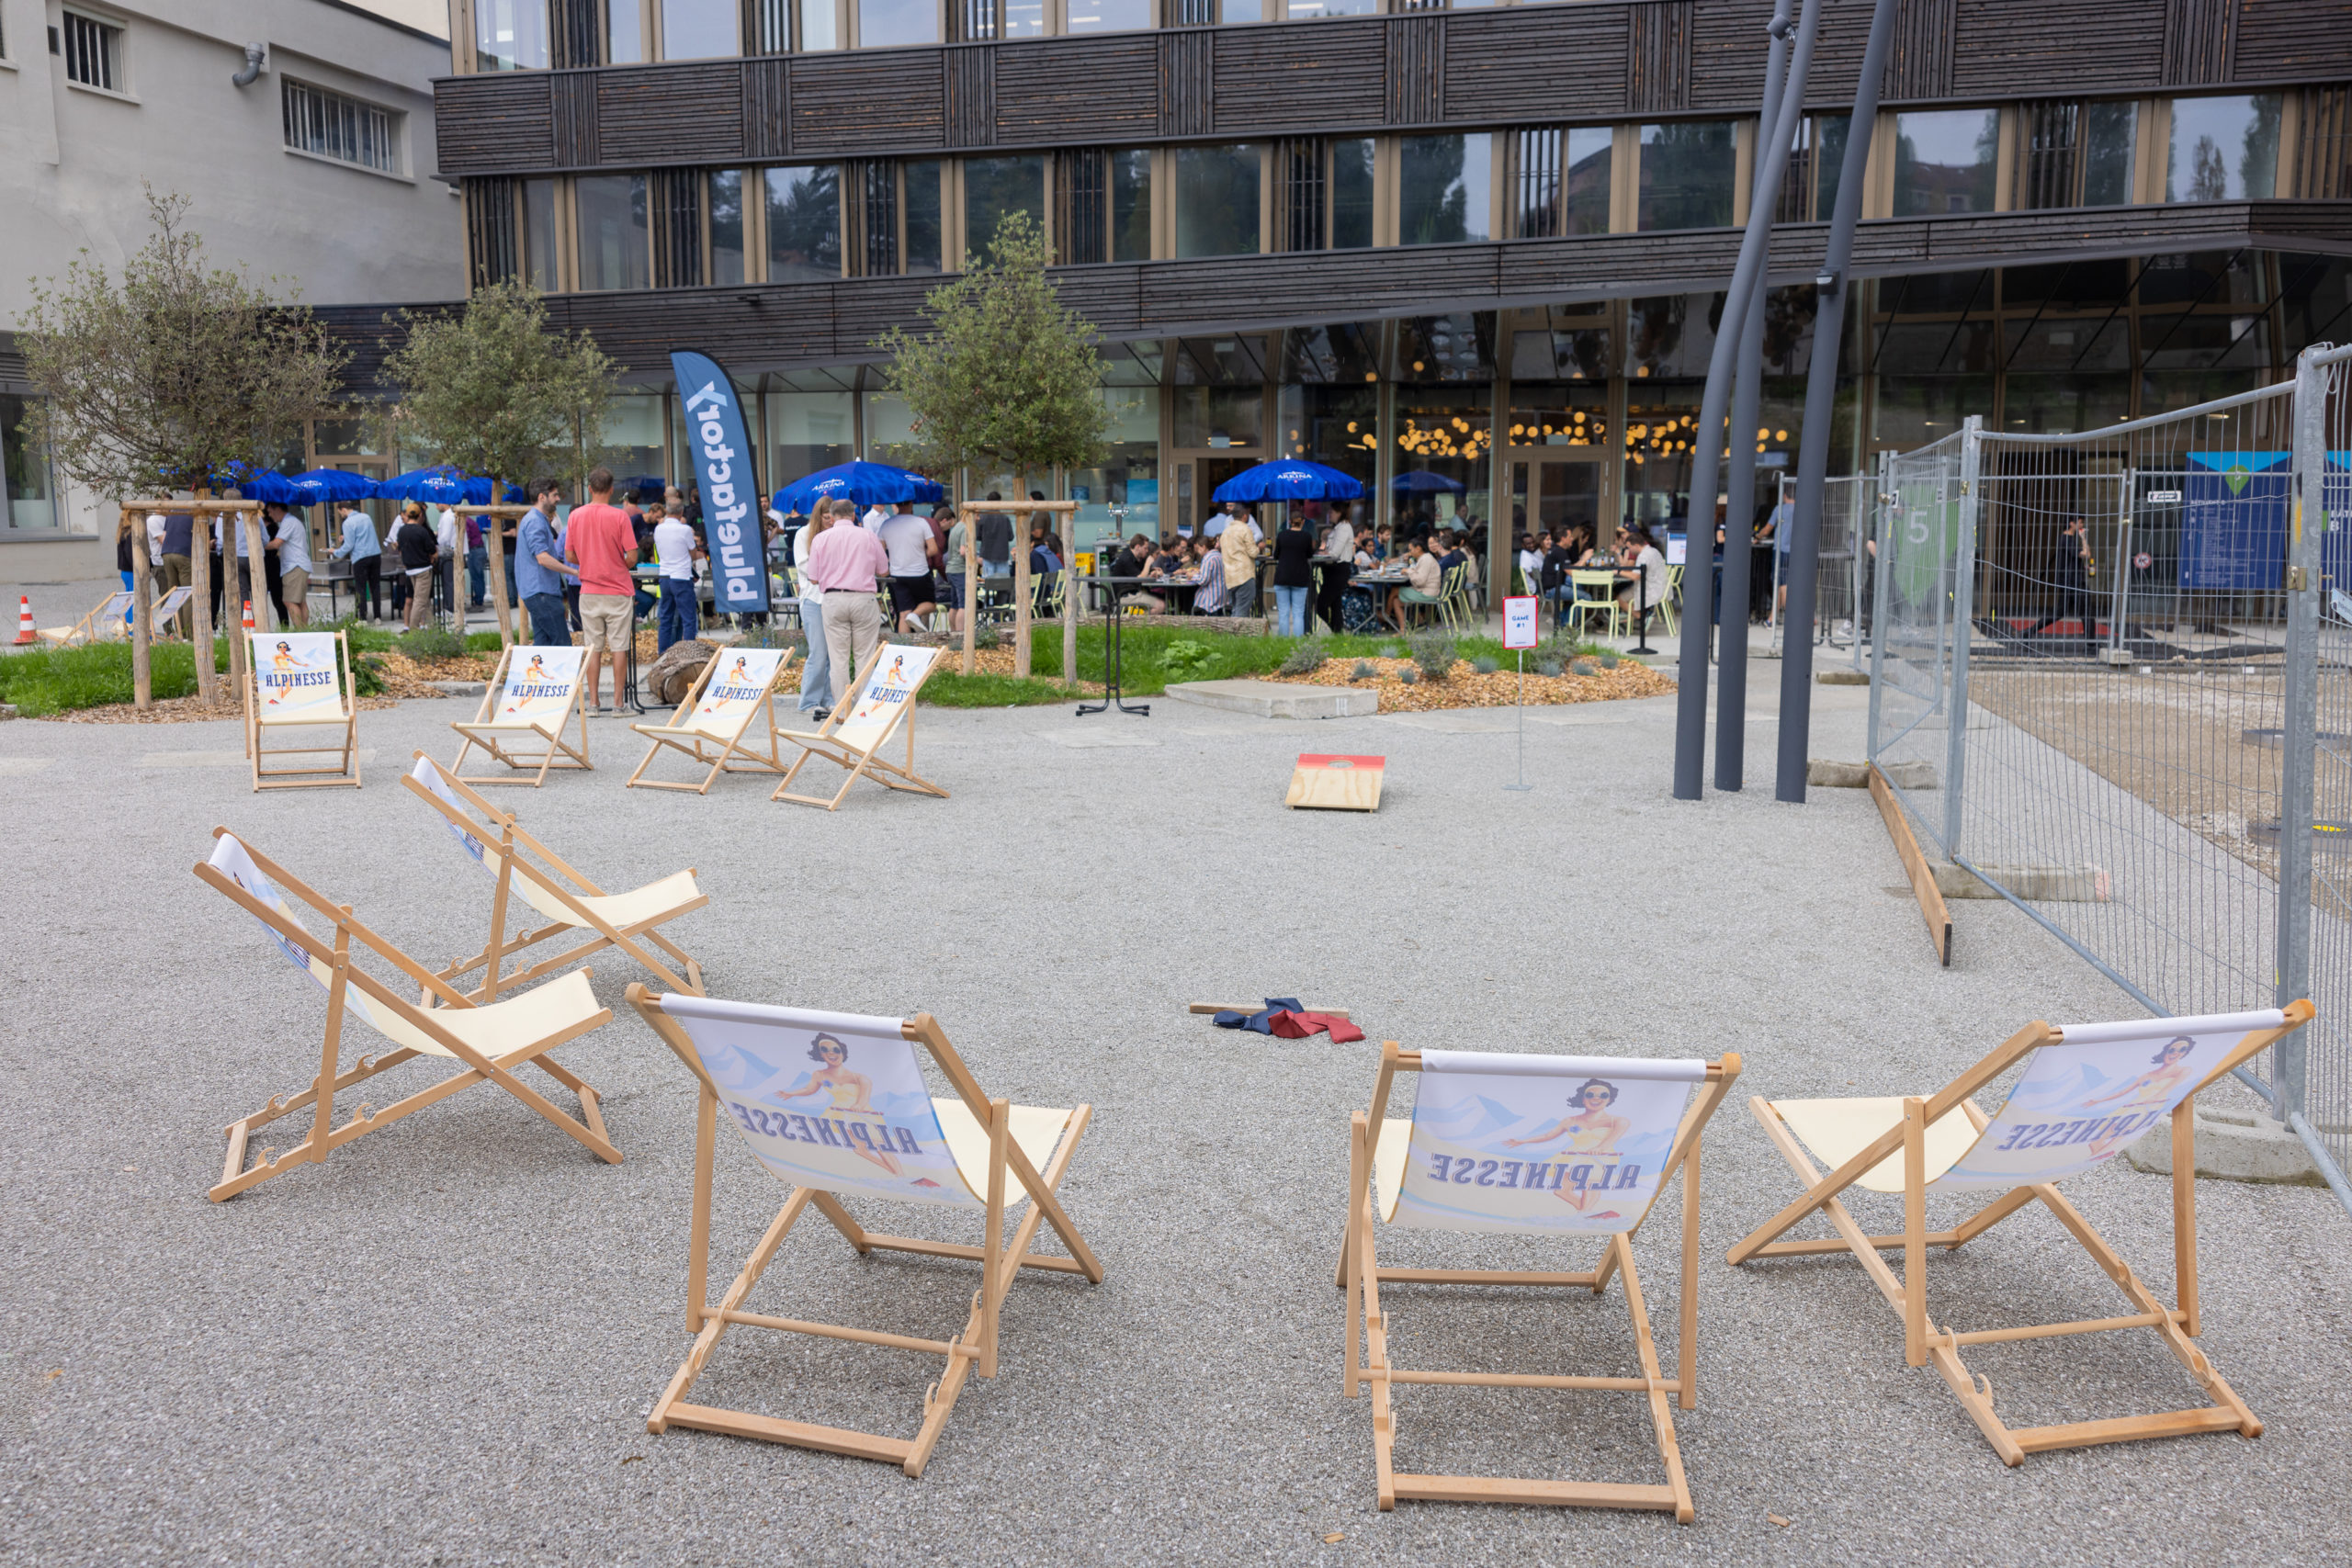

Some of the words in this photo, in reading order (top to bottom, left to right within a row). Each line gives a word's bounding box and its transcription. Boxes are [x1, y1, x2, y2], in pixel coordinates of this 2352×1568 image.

[1908, 511, 1929, 544] 5
[266, 671, 332, 687] ALPINESSE
[511, 684, 570, 697] ALPINESSE
